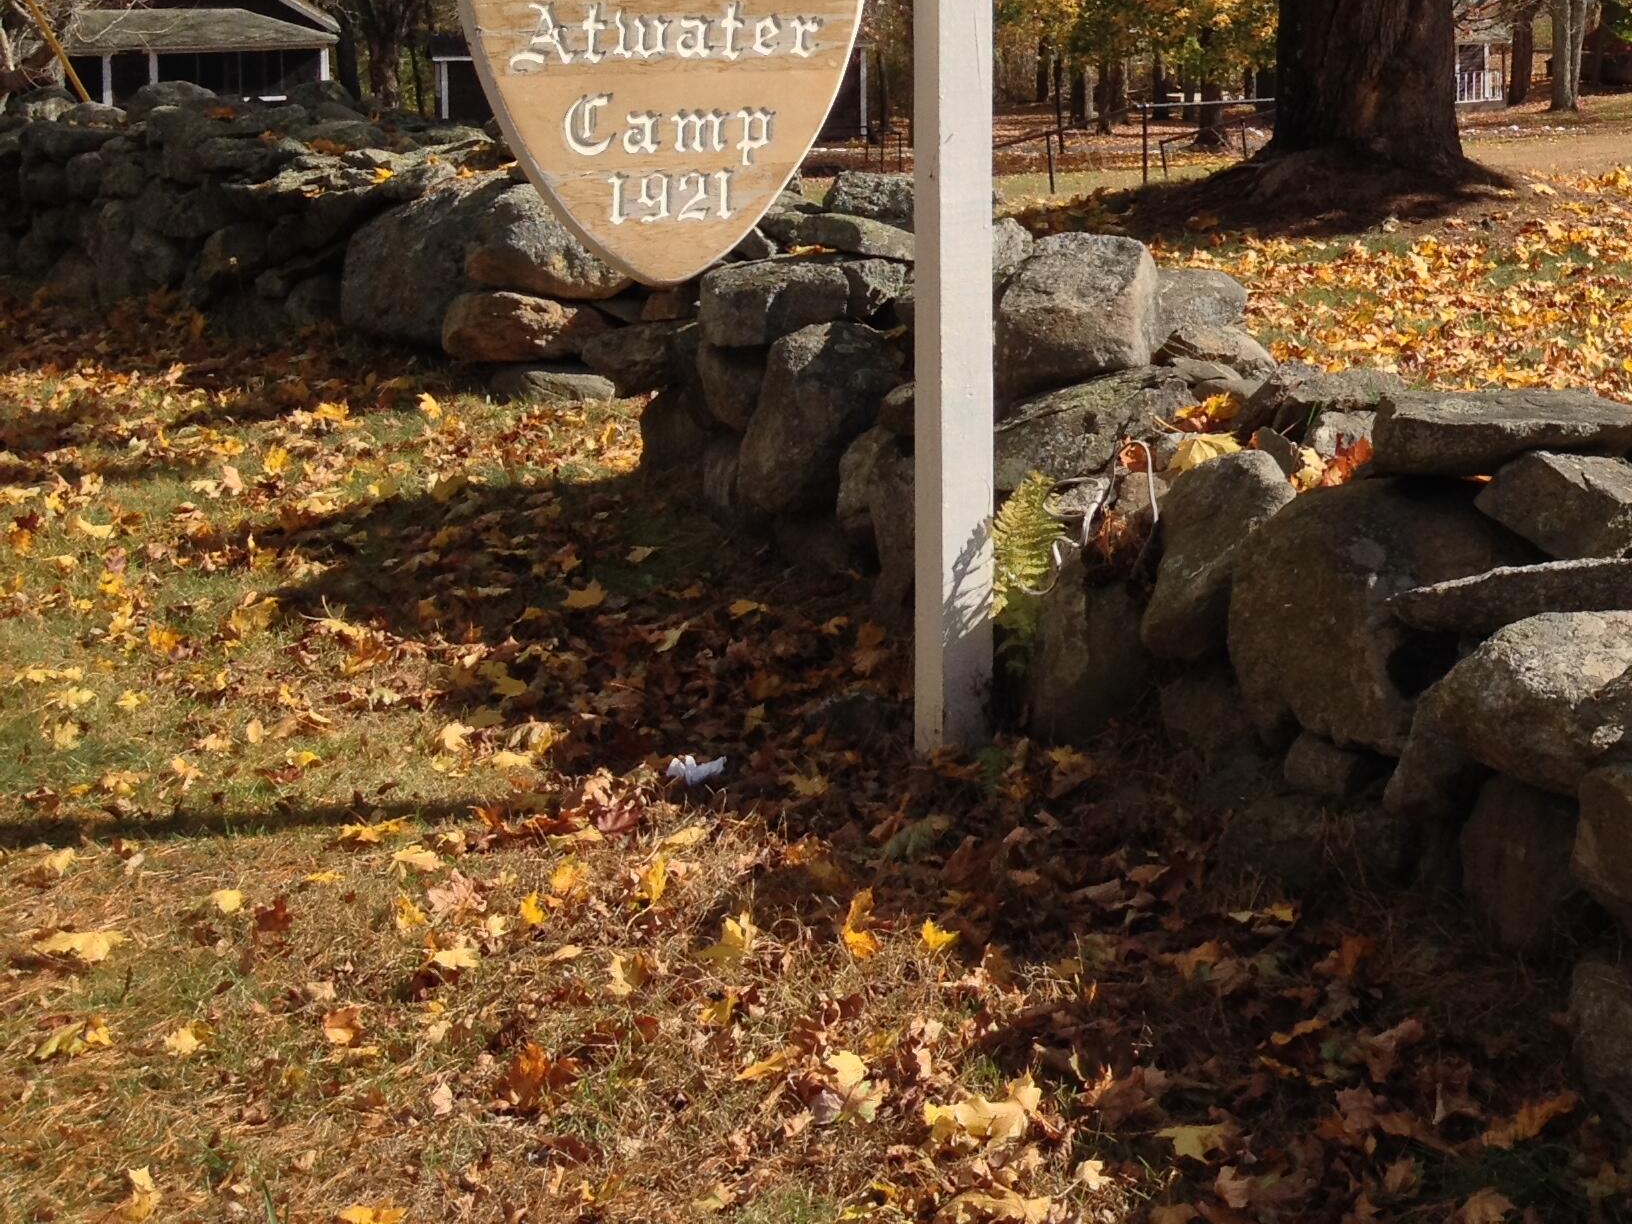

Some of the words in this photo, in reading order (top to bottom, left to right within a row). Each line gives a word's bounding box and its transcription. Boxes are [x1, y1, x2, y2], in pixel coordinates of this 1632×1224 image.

[508, 1, 824, 73] Atwater
[562, 92, 777, 166] Camp
[608, 169, 736, 225] 1921
